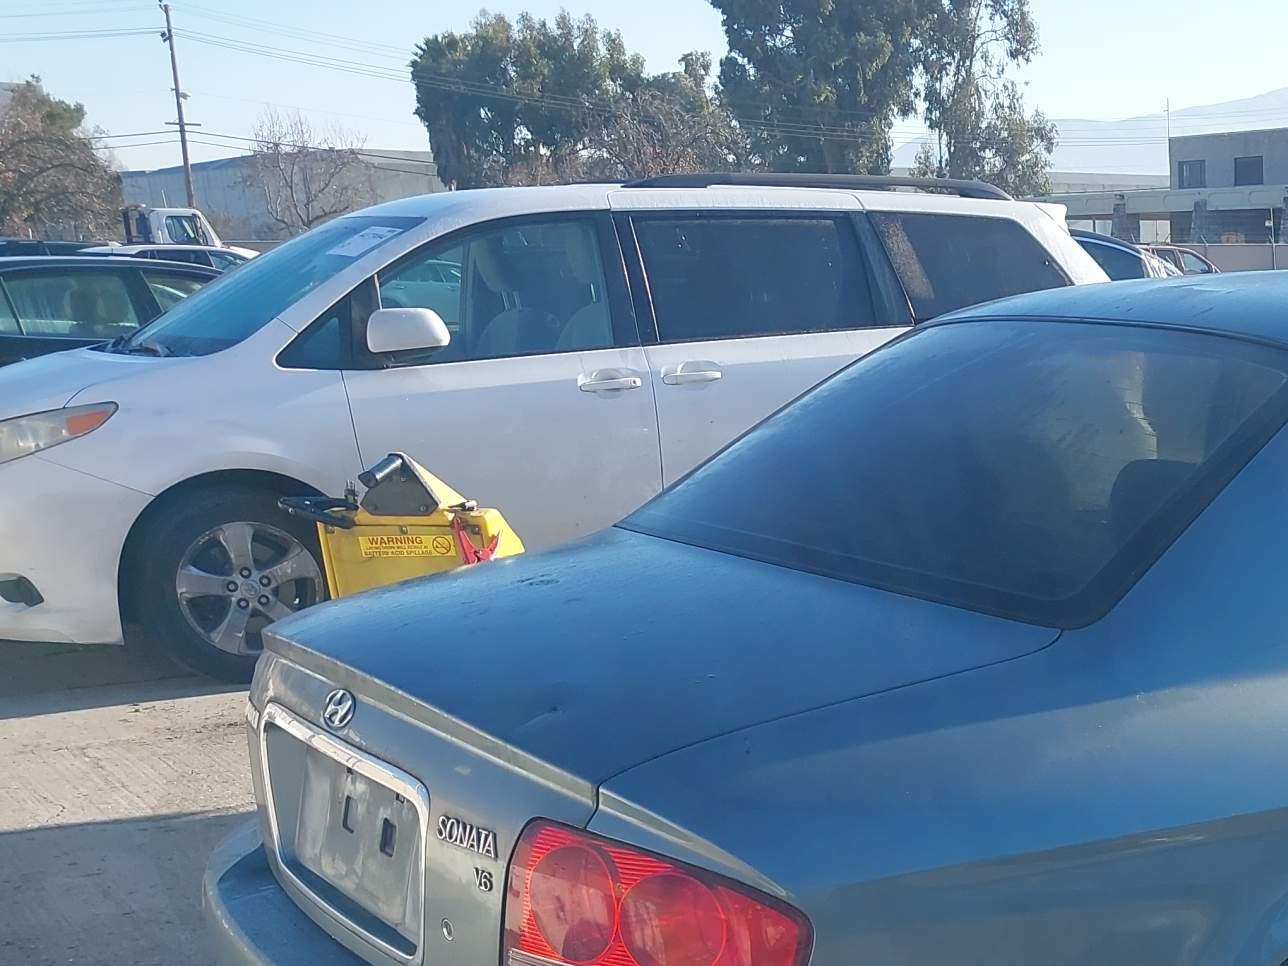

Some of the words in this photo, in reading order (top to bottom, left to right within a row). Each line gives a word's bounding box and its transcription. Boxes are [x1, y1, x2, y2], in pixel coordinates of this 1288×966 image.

[368, 536, 423, 545] WARNING
[437, 815, 496, 858] SONATA
[473, 866, 493, 891] V6
